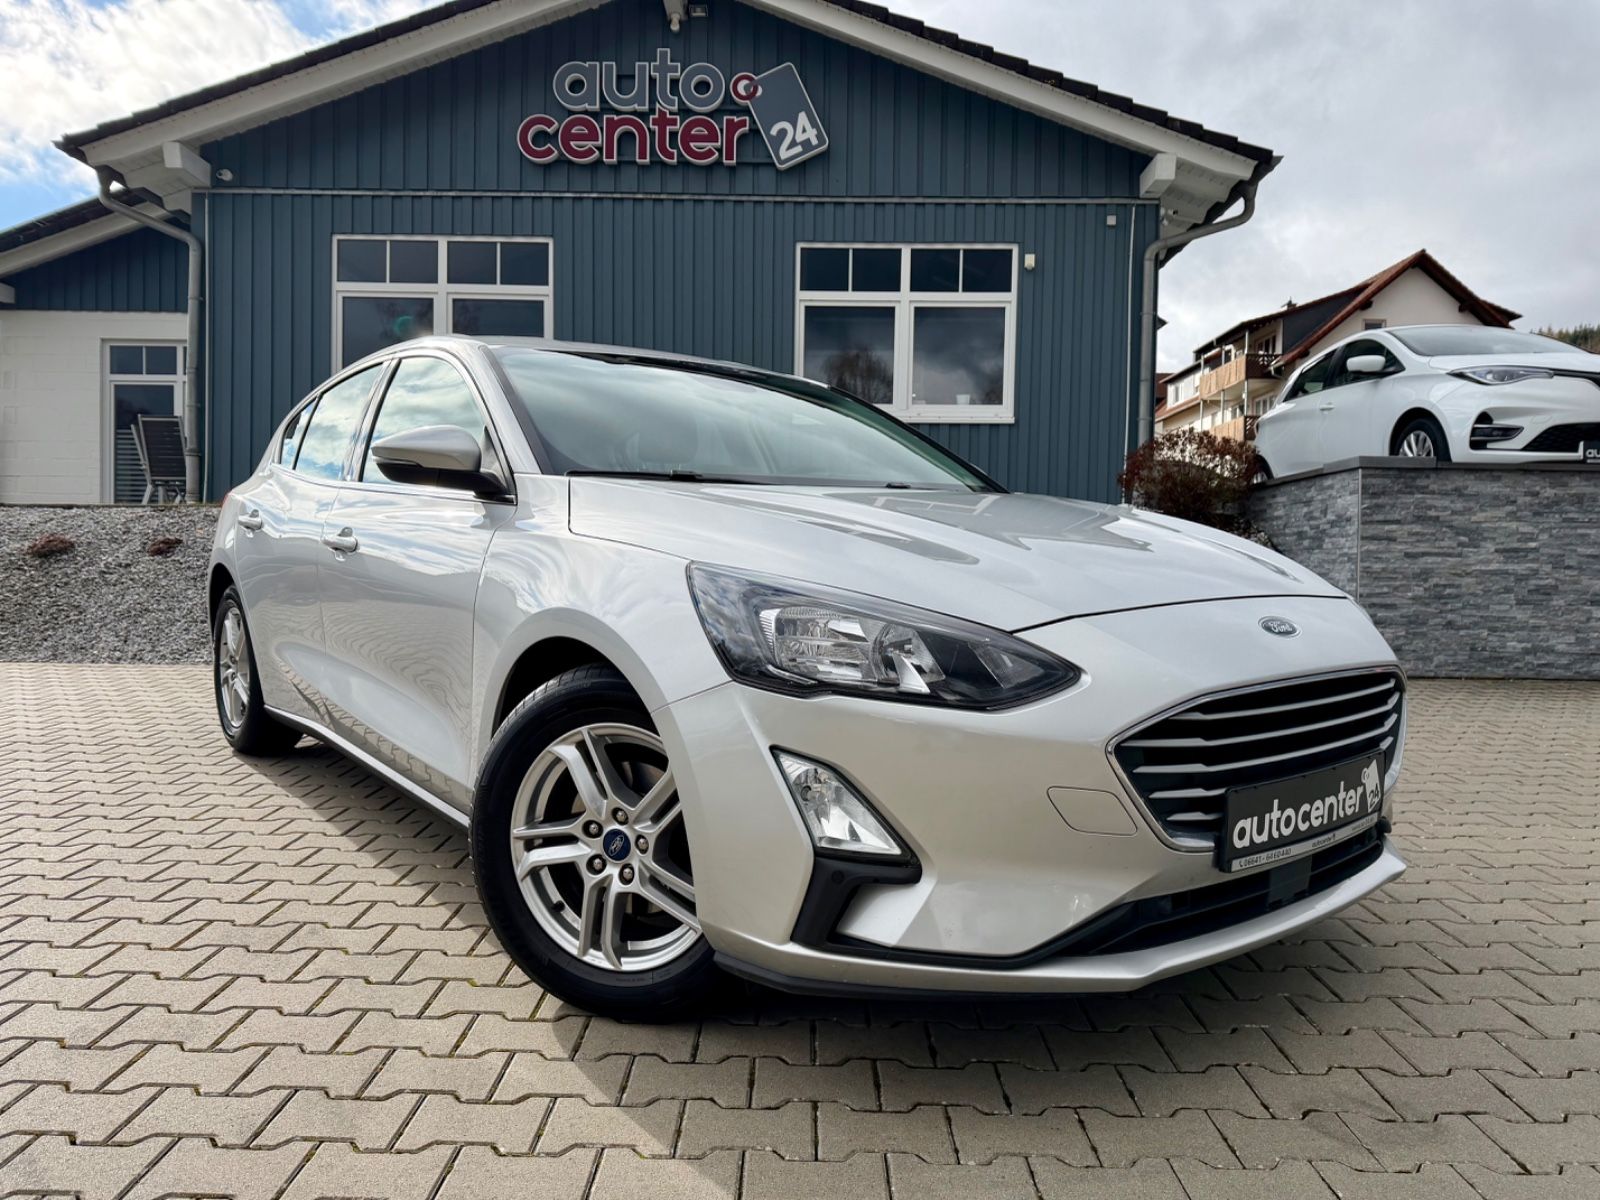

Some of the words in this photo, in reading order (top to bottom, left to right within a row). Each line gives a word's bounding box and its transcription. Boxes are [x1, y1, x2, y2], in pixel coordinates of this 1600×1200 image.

[553, 48, 725, 112] auto
[517, 103, 749, 166] center
[770, 111, 818, 159] 24
[1233, 781, 1364, 849] autocenter
[1368, 782, 1380, 807] 24
